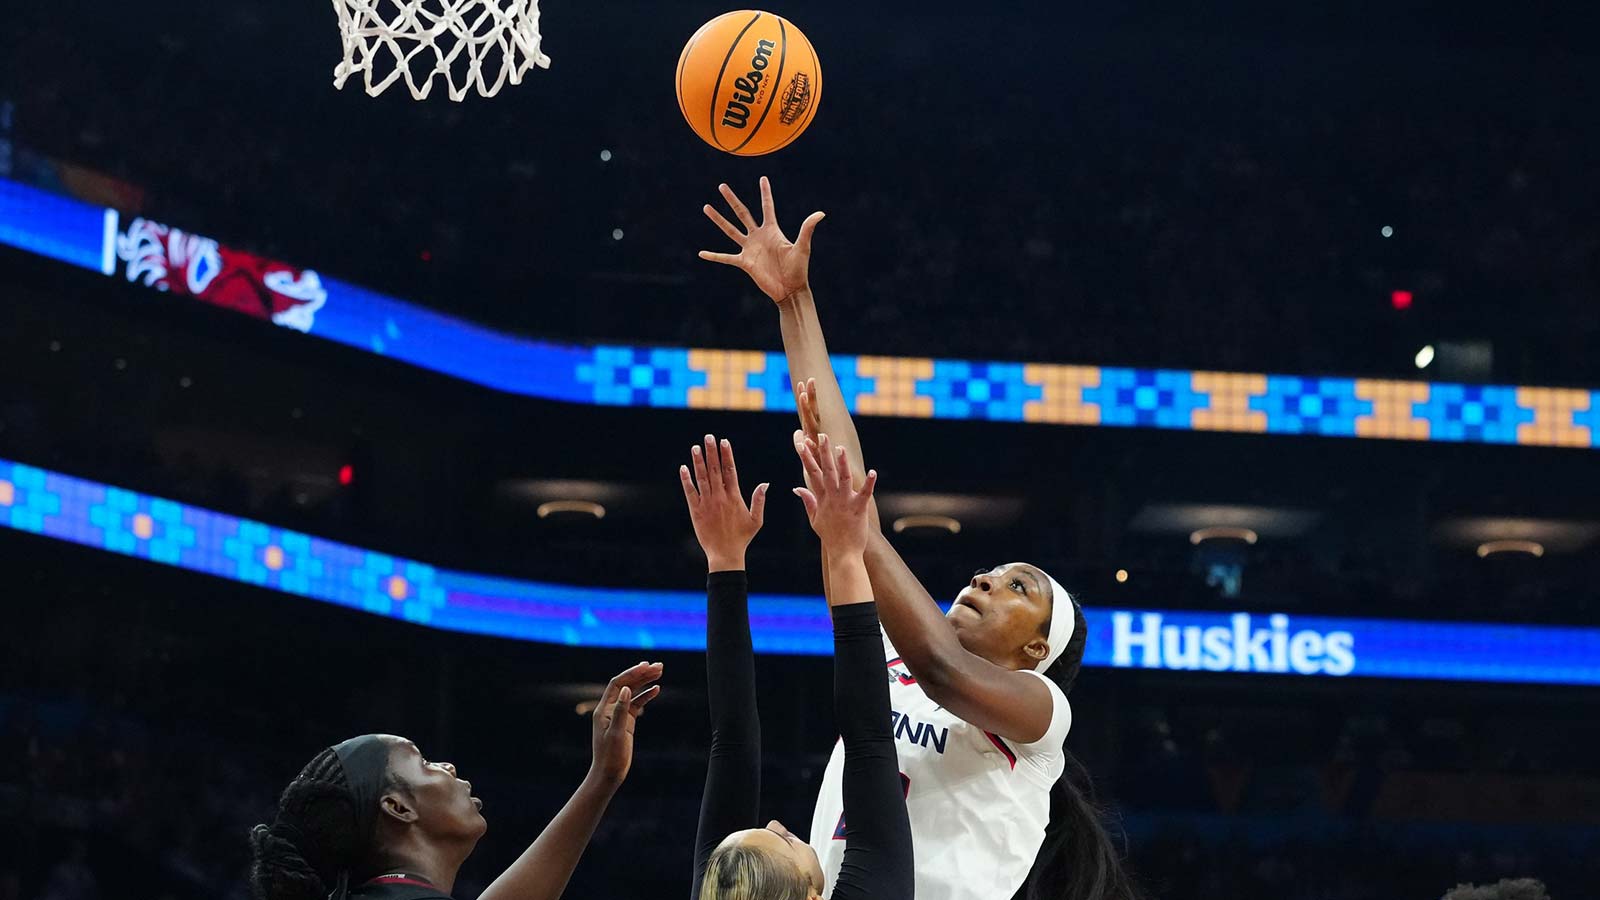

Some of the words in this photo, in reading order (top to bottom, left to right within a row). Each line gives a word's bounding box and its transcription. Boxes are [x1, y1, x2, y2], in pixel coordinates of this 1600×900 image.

[722, 39, 775, 129] Wilson
[782, 100, 801, 124] FINAL
[794, 73, 808, 100] FOUR
[1112, 611, 1356, 676] Huskies
